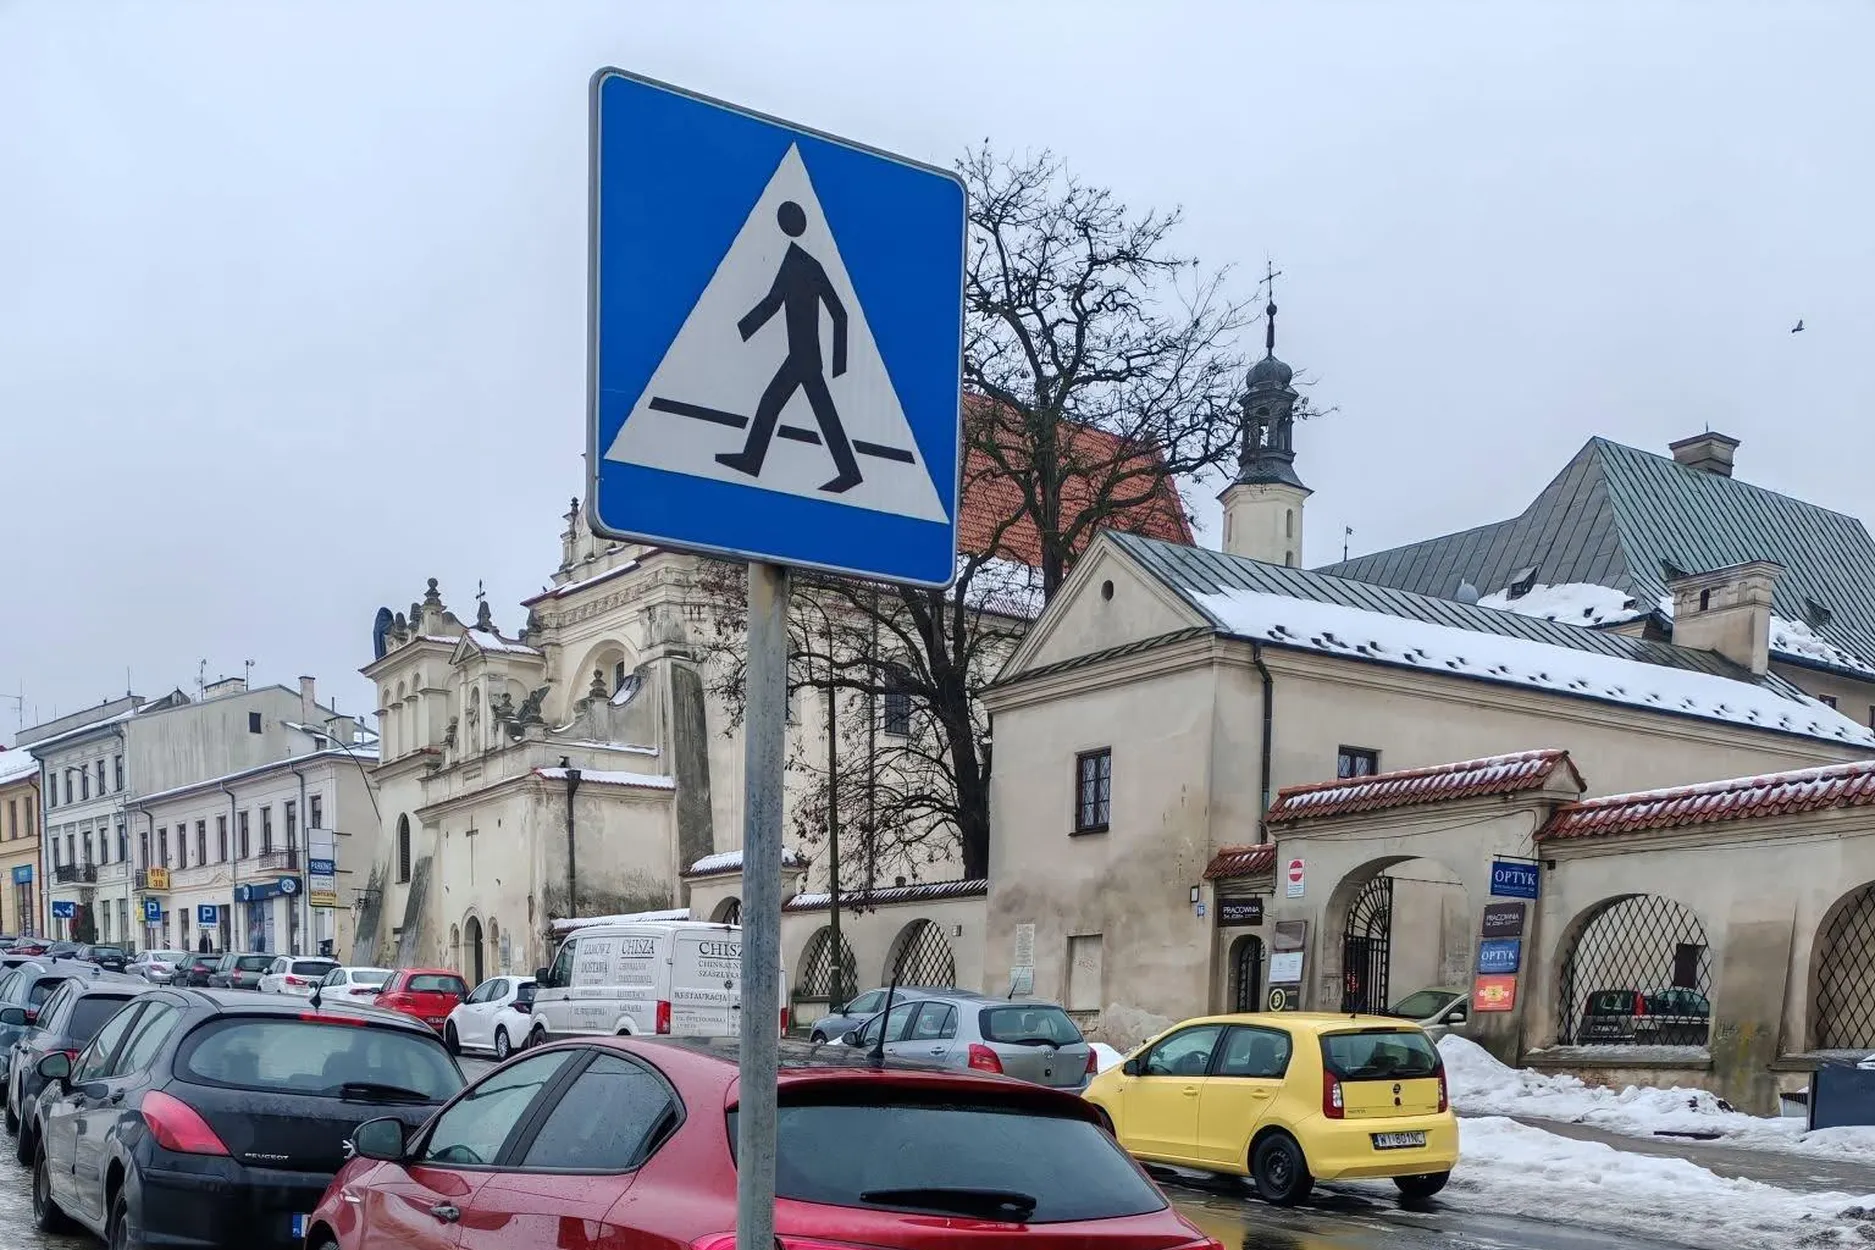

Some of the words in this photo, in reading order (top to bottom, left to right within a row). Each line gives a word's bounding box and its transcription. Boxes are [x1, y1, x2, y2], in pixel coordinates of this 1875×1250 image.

[1495, 870, 1536, 885] OPTYK
[148, 902, 157, 915] P
[203, 907, 213, 920] P
[1223, 906, 1260, 914] PRACOWNIA
[621, 939, 655, 954] CHISZA
[699, 942, 742, 957] CHISZ
[1481, 950, 1515, 960] OPTYK
